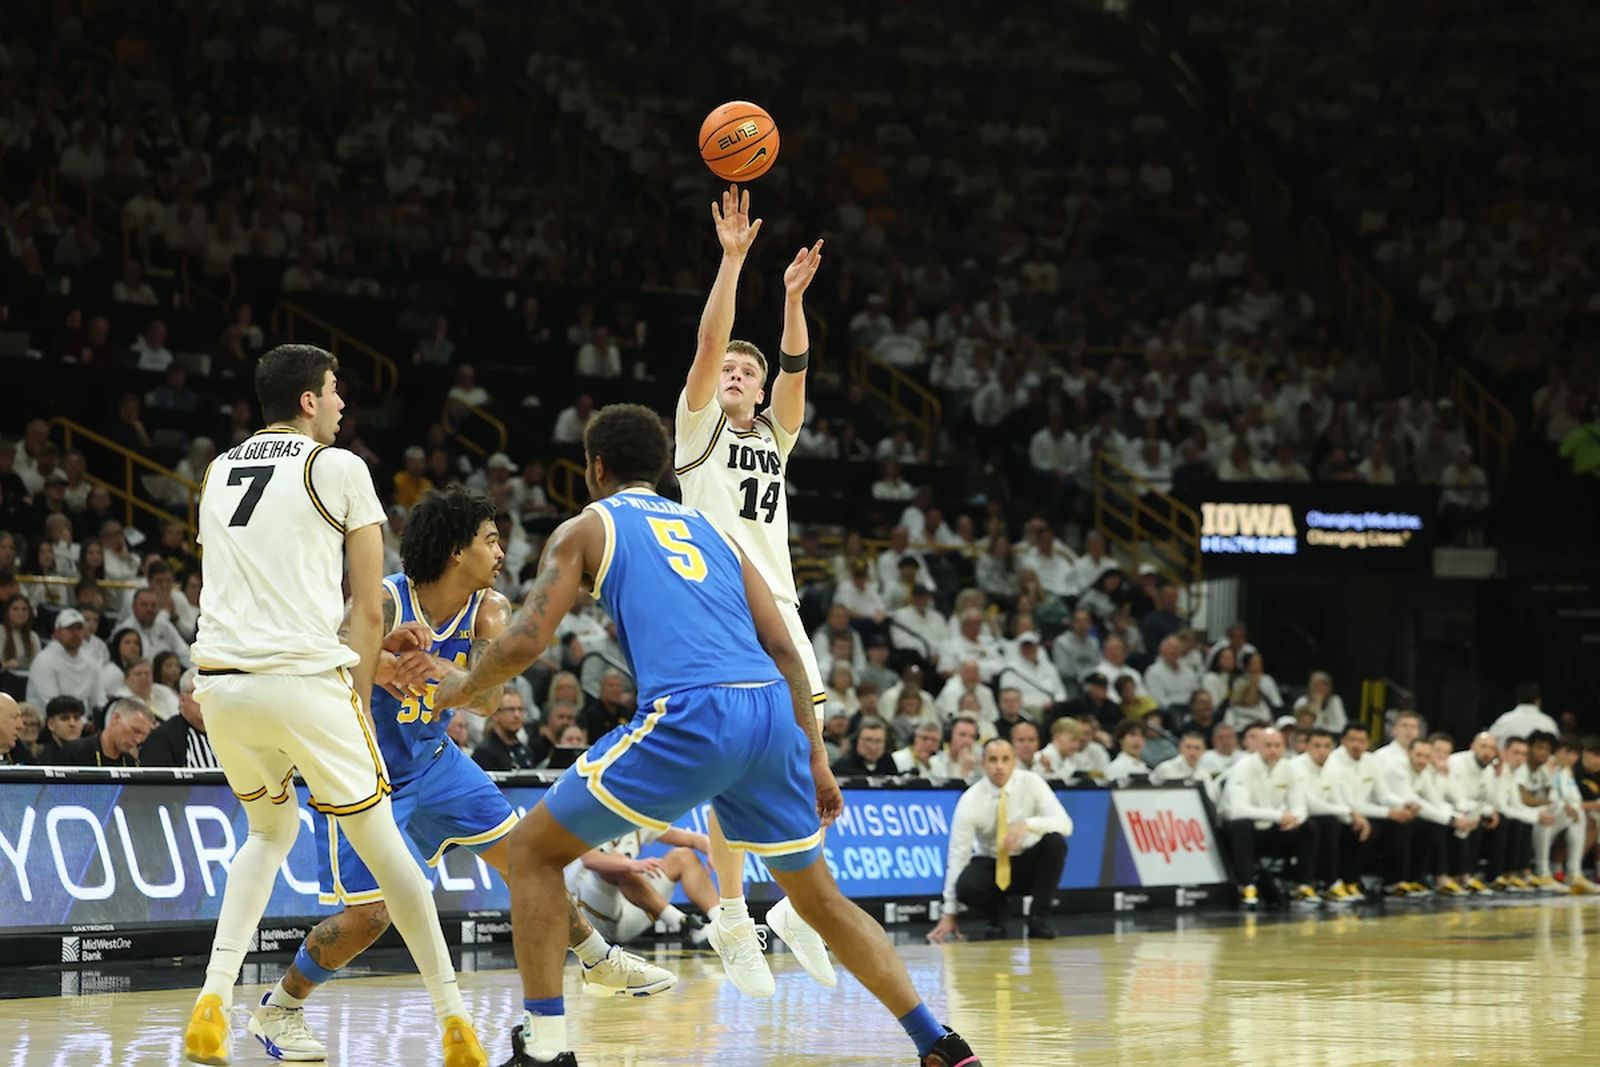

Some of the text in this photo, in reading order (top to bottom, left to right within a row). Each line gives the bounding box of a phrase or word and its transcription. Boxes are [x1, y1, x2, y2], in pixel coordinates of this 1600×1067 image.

[718, 120, 758, 150] ELITE
[220, 440, 304, 460] OLGUEIRAS
[226, 464, 275, 527] 7
[739, 476, 781, 523] 14
[1200, 502, 1297, 536] IOWA
[645, 516, 709, 583] 5
[835, 804, 949, 837] MISSION
[0, 805, 237, 901] YOUR
[81, 950, 103, 962] Bank
[82, 937, 132, 950] MidWestOne
